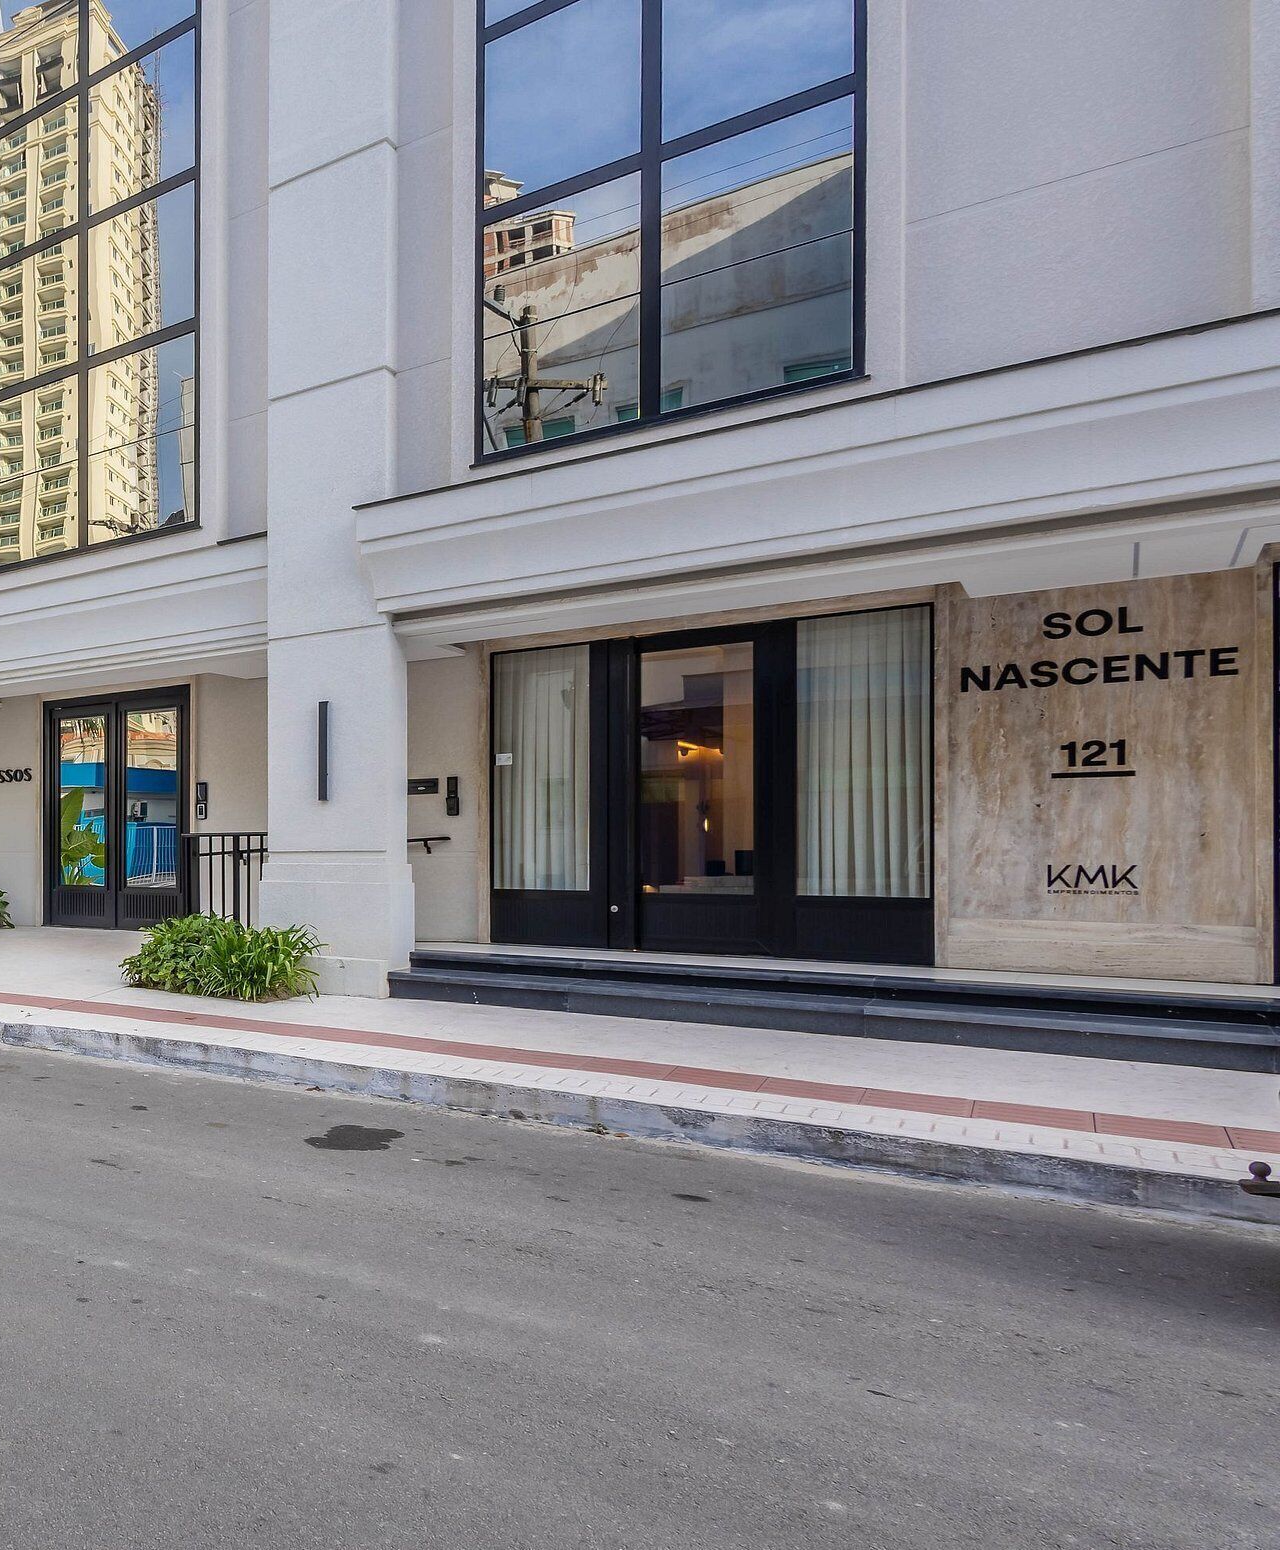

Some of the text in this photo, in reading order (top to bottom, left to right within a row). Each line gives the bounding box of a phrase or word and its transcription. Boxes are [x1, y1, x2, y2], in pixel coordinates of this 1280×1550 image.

[1043, 607, 1143, 639] SOL
[960, 647, 1239, 692] NASCENTE
[1060, 739, 1126, 767] 121
[1047, 864, 1138, 889] KMK
